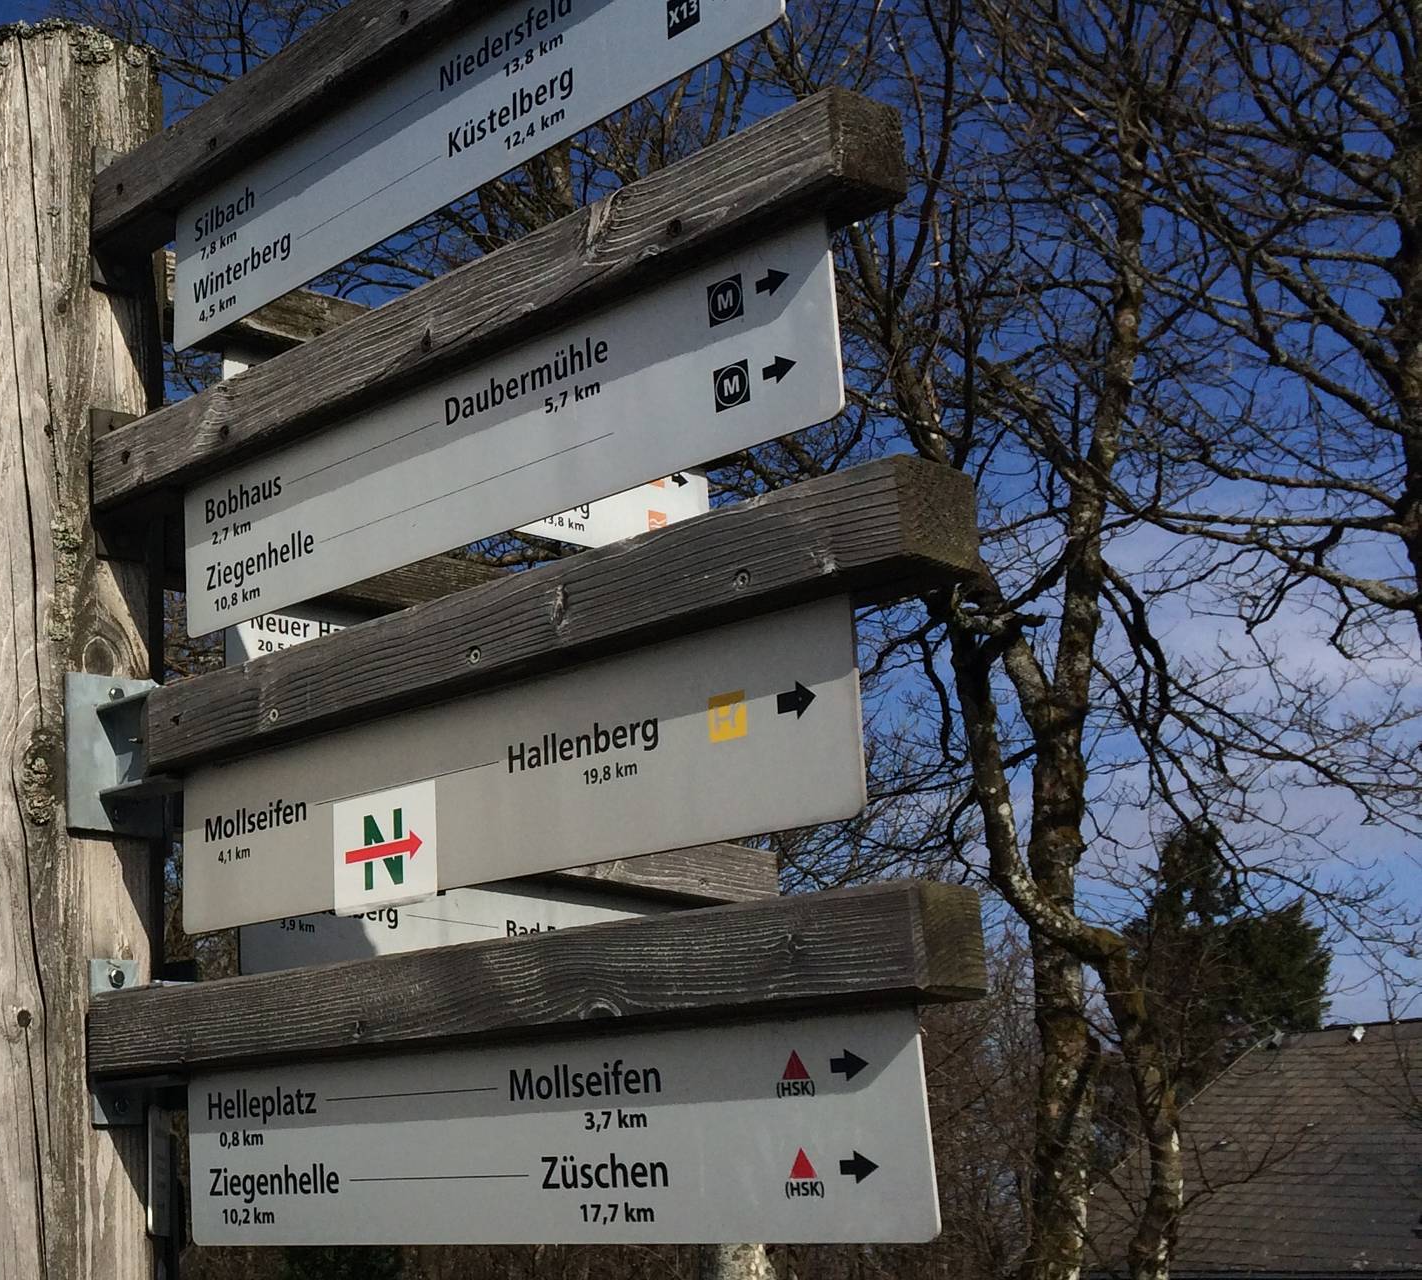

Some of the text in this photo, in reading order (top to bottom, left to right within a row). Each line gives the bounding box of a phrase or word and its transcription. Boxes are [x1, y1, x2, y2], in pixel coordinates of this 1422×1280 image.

[503, 34, 563, 77] 13,8 km
[448, 66, 574, 158] Küstelberg
[505, 109, 564, 150] 12,4 km
[194, 187, 255, 242] Silbach
[201, 232, 236, 260] 7,8 km
[192, 231, 292, 304] Winterberg
[199, 295, 236, 322] 4,5 km
[717, 289, 733, 312] M
[445, 336, 609, 426] Daubermühle
[723, 376, 740, 397] M
[545, 382, 600, 414] 5,7 km
[203, 477, 282, 525] Bobhaus
[212, 521, 251, 545] 2,7 km
[568, 518, 585, 531] km
[205, 530, 314, 591] Ziegenhelle
[215, 587, 260, 611] 10,8 km
[250, 615, 310, 638] Neuer
[507, 717, 660, 774] Hallenberg
[583, 762, 637, 784] 19,8 km
[205, 799, 306, 842] Mollseifen
[218, 847, 250, 864] 4,1 km
[363, 807, 404, 890] N
[298, 920, 315, 933] km
[510, 1060, 661, 1101] Mollseifen
[776, 1079, 815, 1098] (HSK)
[208, 1086, 316, 1124] Helleplatz
[585, 1109, 647, 1132] 3,7 km
[220, 1130, 263, 1149] 0,8 km
[210, 1163, 339, 1204] Ziegenhelle
[541, 1153, 668, 1189] Züschen
[784, 1179, 824, 1198] (HSK)
[223, 1207, 274, 1226] 10,2 km
[580, 1202, 654, 1225] 17,7 km
